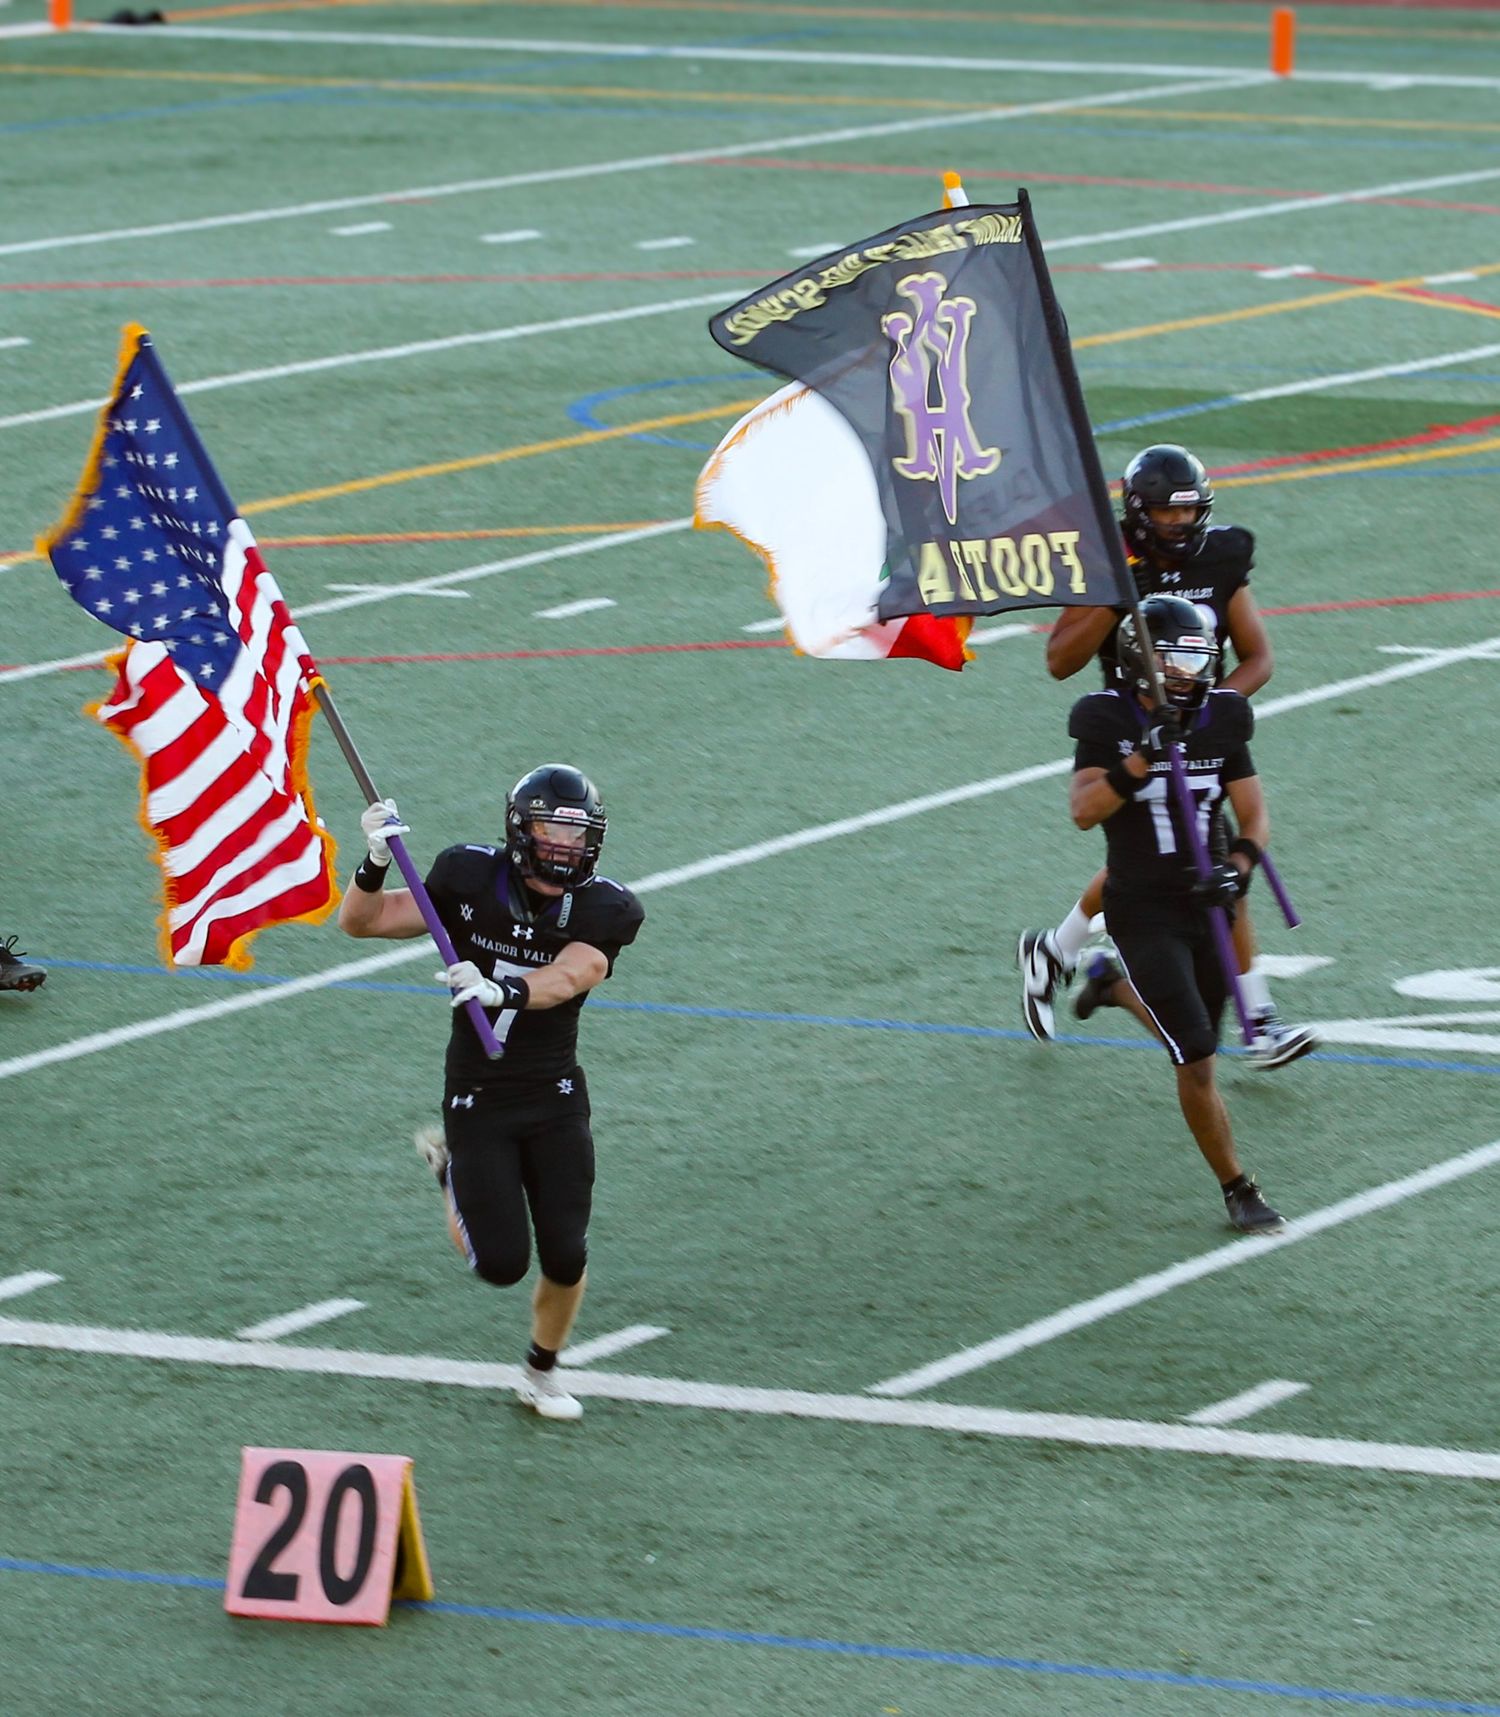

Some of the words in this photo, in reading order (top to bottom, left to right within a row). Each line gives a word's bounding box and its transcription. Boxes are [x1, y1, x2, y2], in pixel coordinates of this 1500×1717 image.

[1133, 773, 1222, 855] 17
[470, 932, 518, 957] AMADOR
[523, 948, 553, 964] VALL
[241, 1461, 378, 1605] 20
